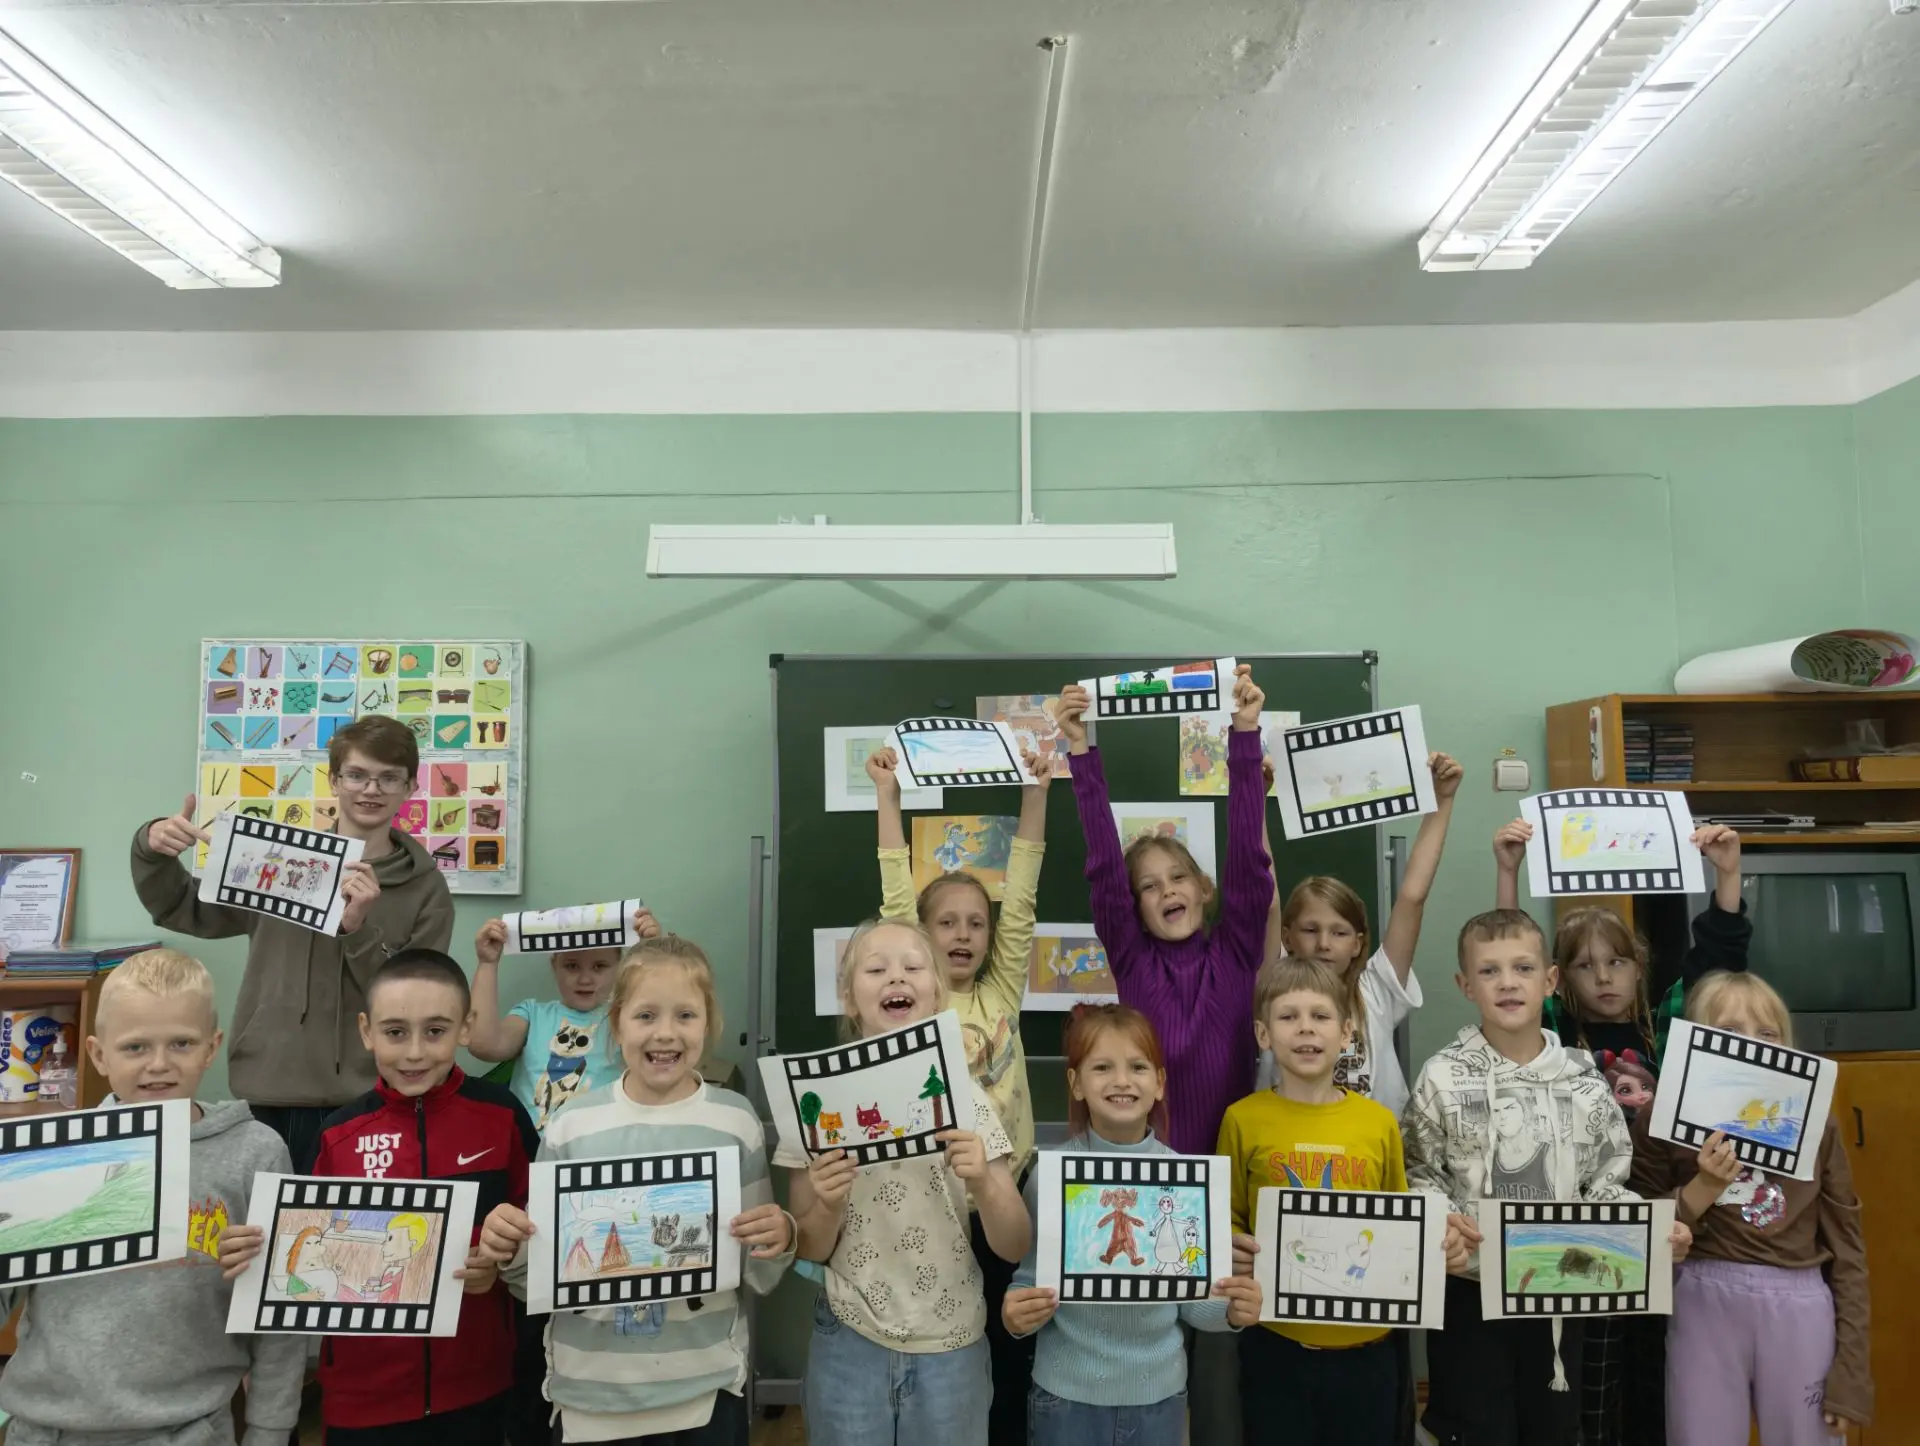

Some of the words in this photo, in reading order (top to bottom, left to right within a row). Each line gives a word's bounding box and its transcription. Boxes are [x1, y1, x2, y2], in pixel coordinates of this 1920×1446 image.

[355, 1132, 402, 1153] JUST
[363, 1150, 394, 1169] DO
[1268, 1151, 1368, 1187] SHARK
